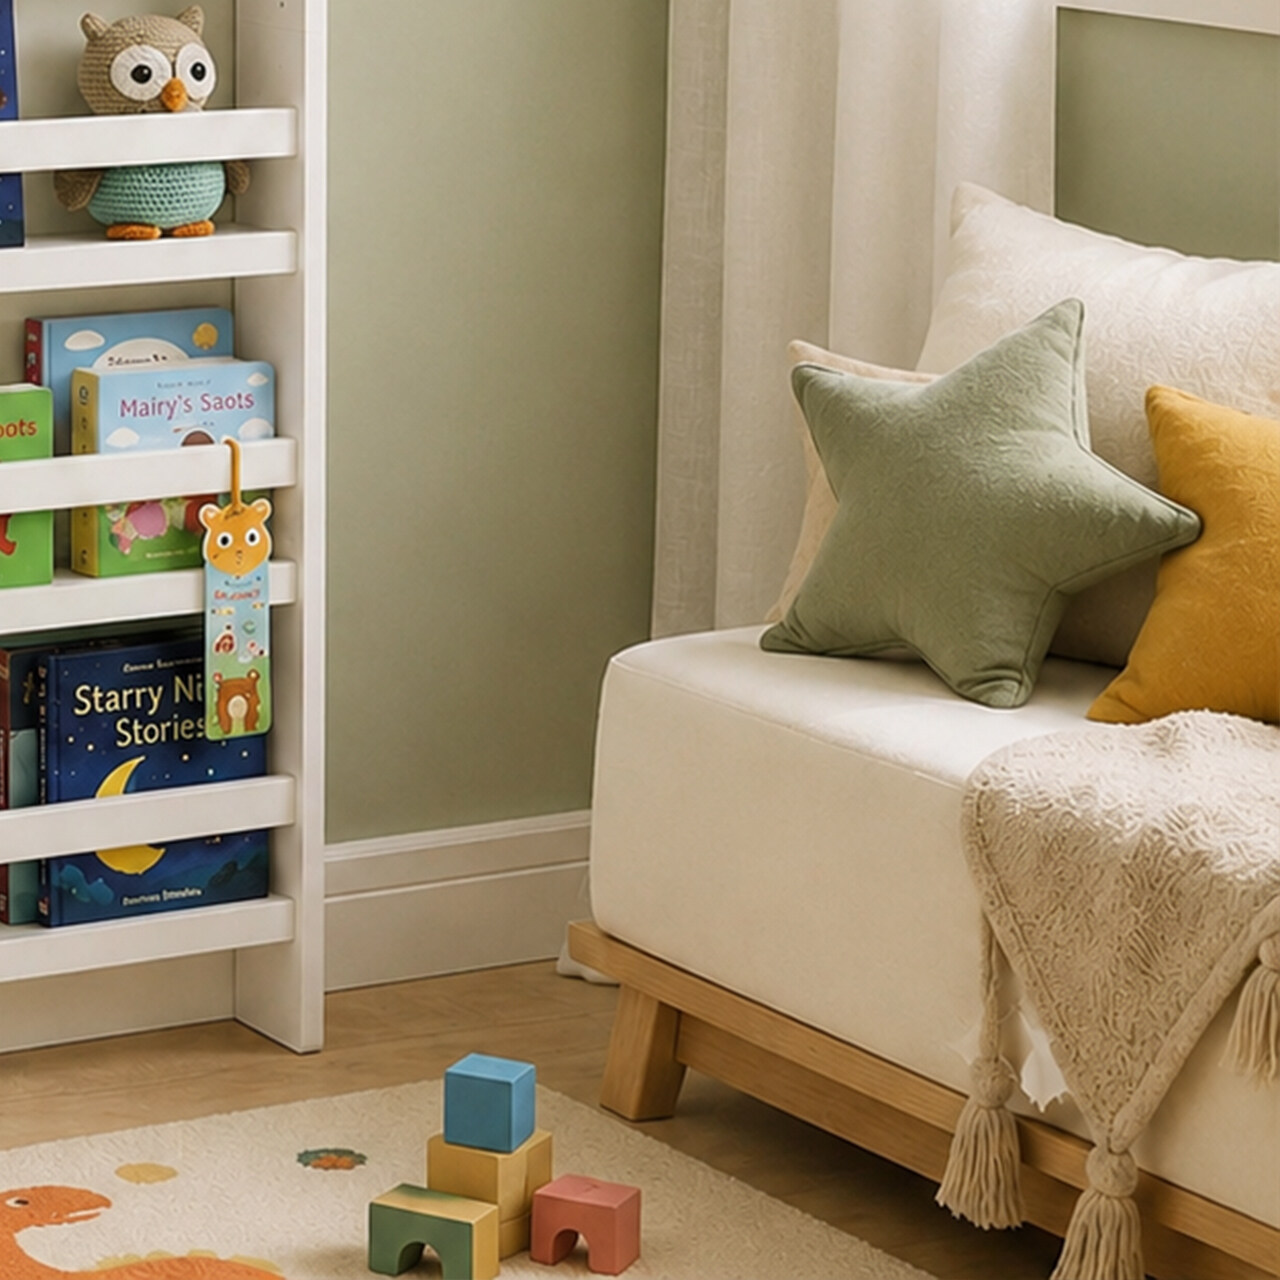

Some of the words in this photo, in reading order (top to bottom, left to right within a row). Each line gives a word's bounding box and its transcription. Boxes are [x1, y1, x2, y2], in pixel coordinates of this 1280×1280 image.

[120, 395, 192, 421] Mairy's
[201, 391, 255, 413] Saots
[73, 683, 164, 716] Starry
